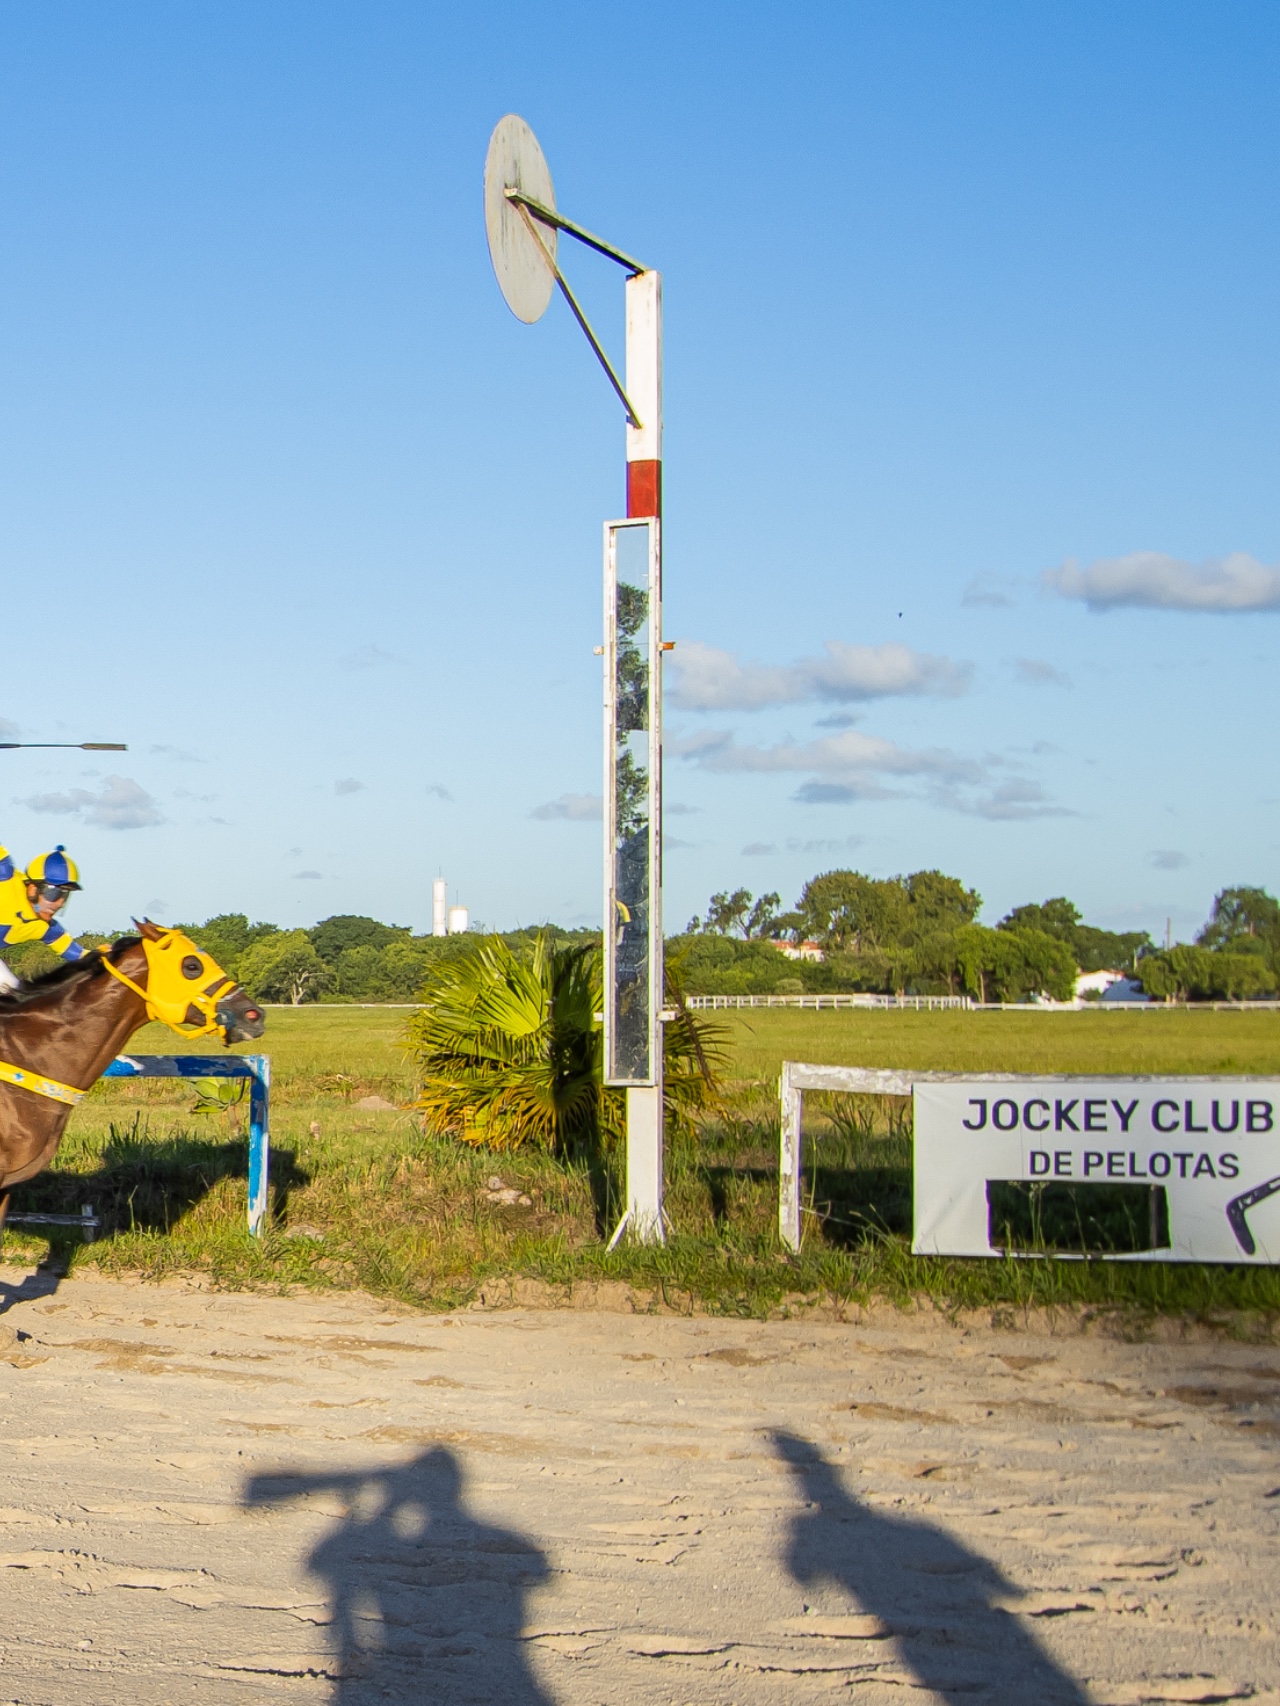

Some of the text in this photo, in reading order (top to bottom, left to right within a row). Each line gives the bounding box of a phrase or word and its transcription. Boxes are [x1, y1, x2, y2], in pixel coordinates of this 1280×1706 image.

[962, 1098, 1274, 1133] JOCKEY CLUB
[1030, 1151, 1240, 1179] DE PELOTAS
